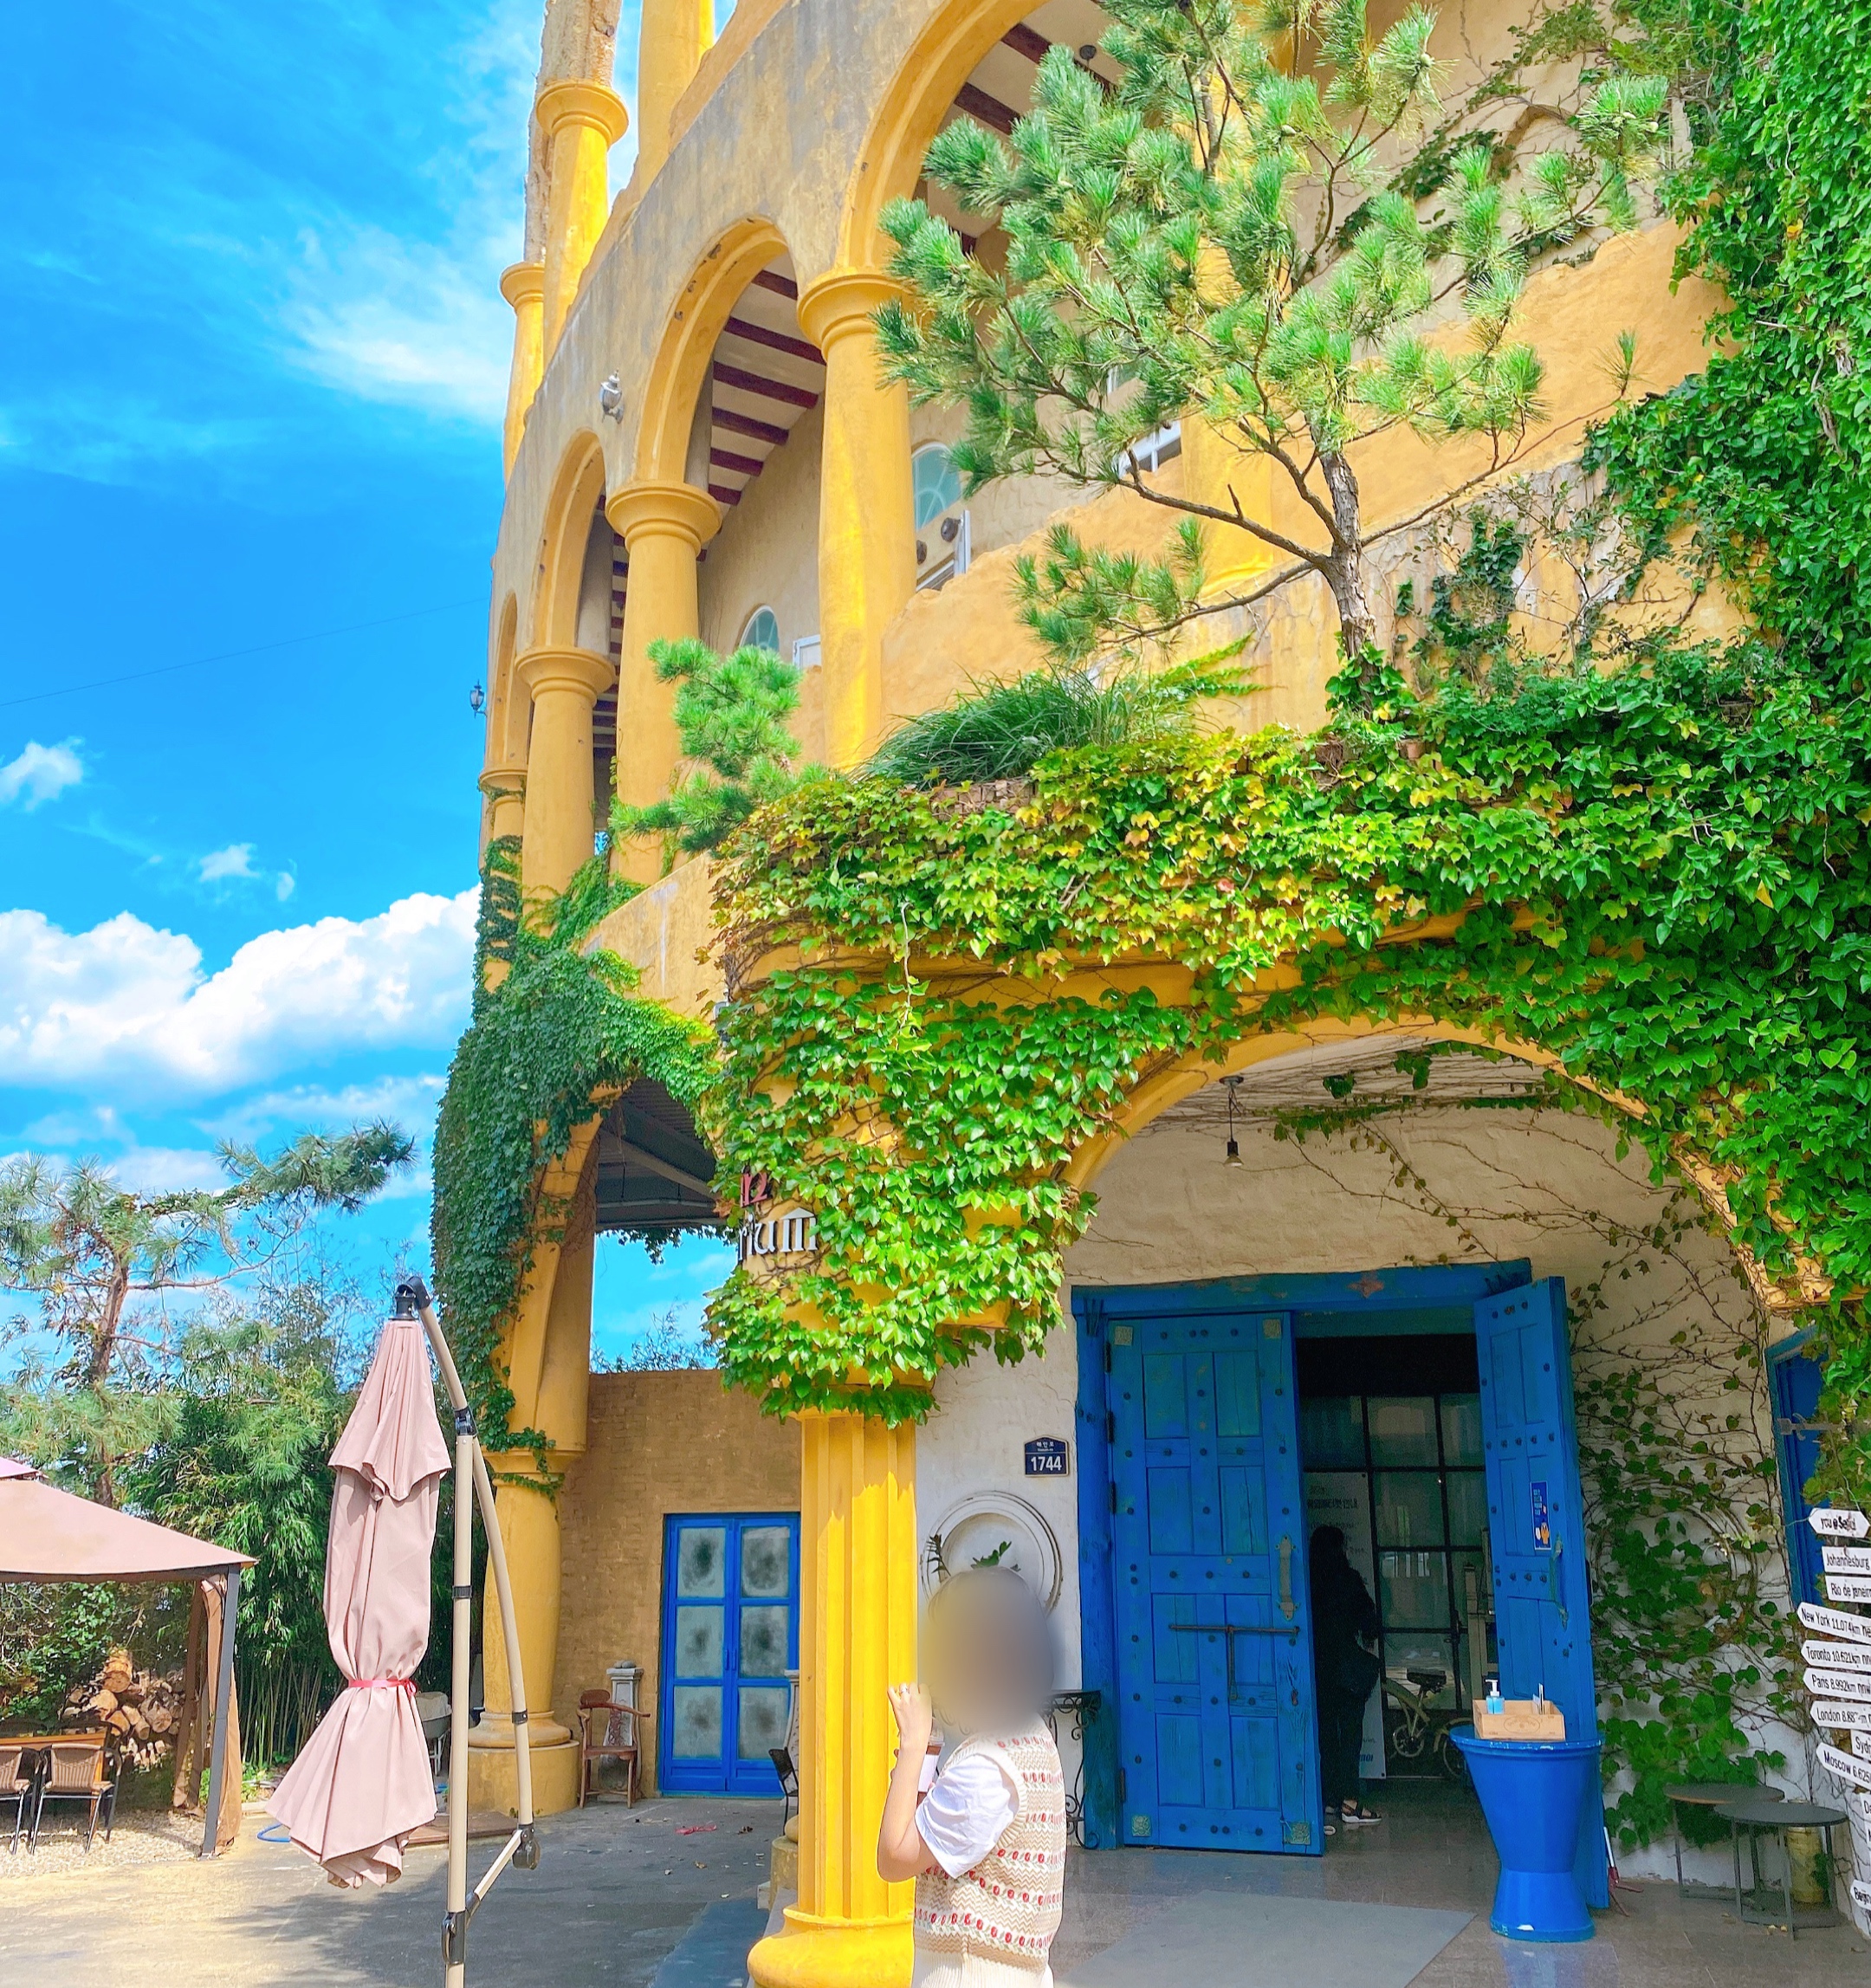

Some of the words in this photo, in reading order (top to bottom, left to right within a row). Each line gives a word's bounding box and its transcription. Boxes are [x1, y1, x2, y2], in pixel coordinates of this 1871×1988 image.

[1031, 1455, 1062, 1471] 1744
[1826, 1553, 1870, 1570] Johannesburg
[1830, 1583, 1842, 1596] Rio
[1842, 1583, 1851, 1596] de
[1802, 1608, 1815, 1622] New
[1815, 1611, 1830, 1628] York
[1806, 1646, 1831, 1661] Toronto
[1811, 1674, 1829, 1689] Paris
[1816, 1706, 1841, 1722] London
[1823, 1750, 1851, 1774] Moscow
